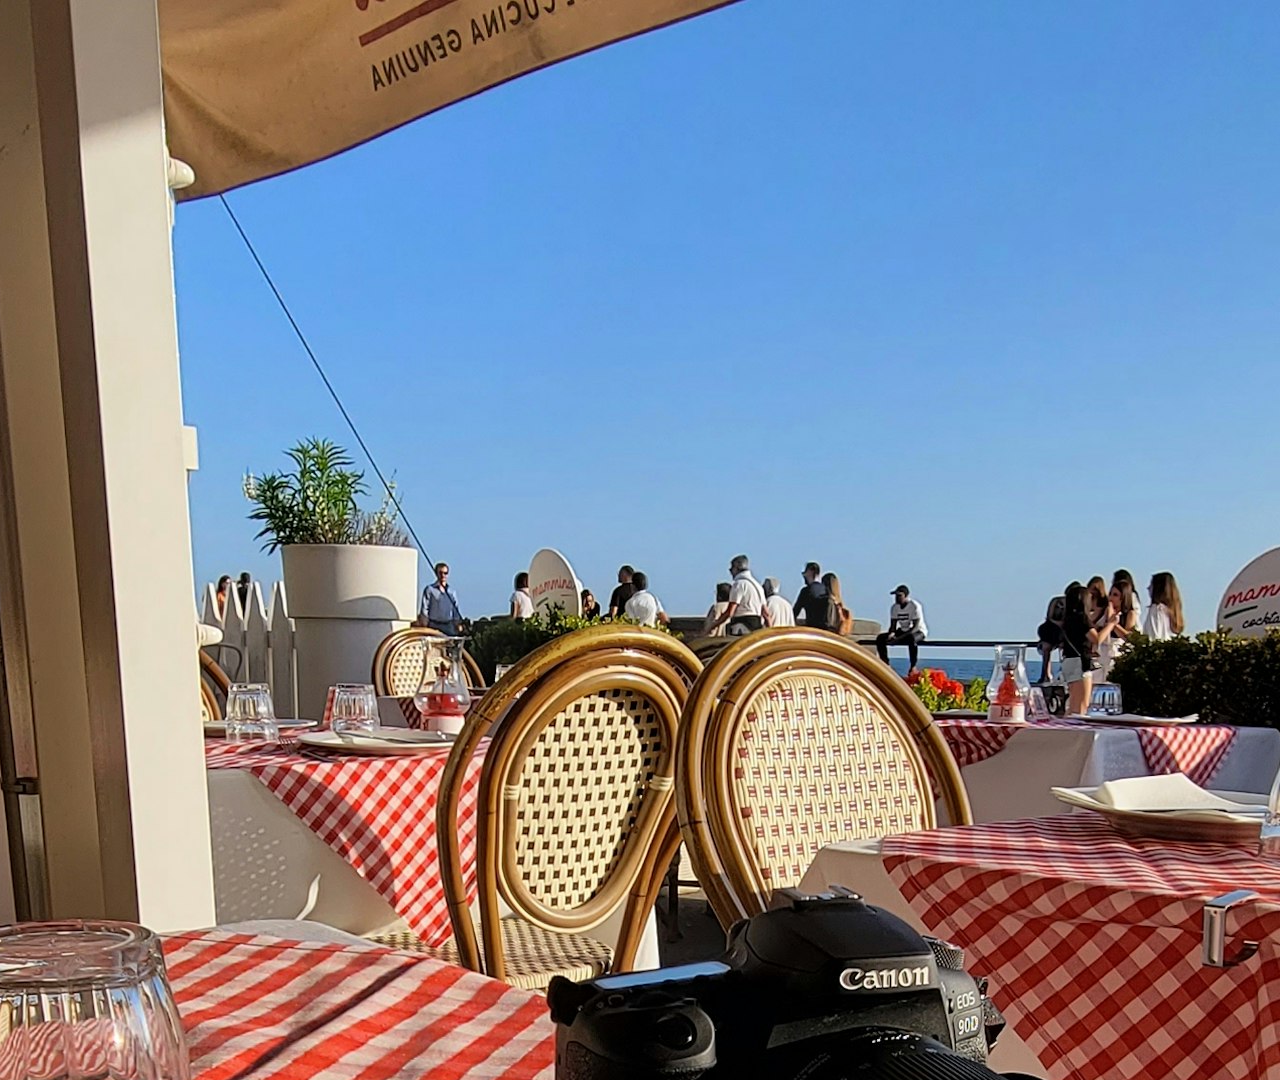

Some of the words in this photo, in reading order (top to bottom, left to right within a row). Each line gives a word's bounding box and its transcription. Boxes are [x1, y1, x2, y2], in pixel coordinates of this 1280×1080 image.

[839, 966, 930, 990] Canon
[956, 991, 976, 1009] EOS
[958, 1015, 979, 1035] 90D
